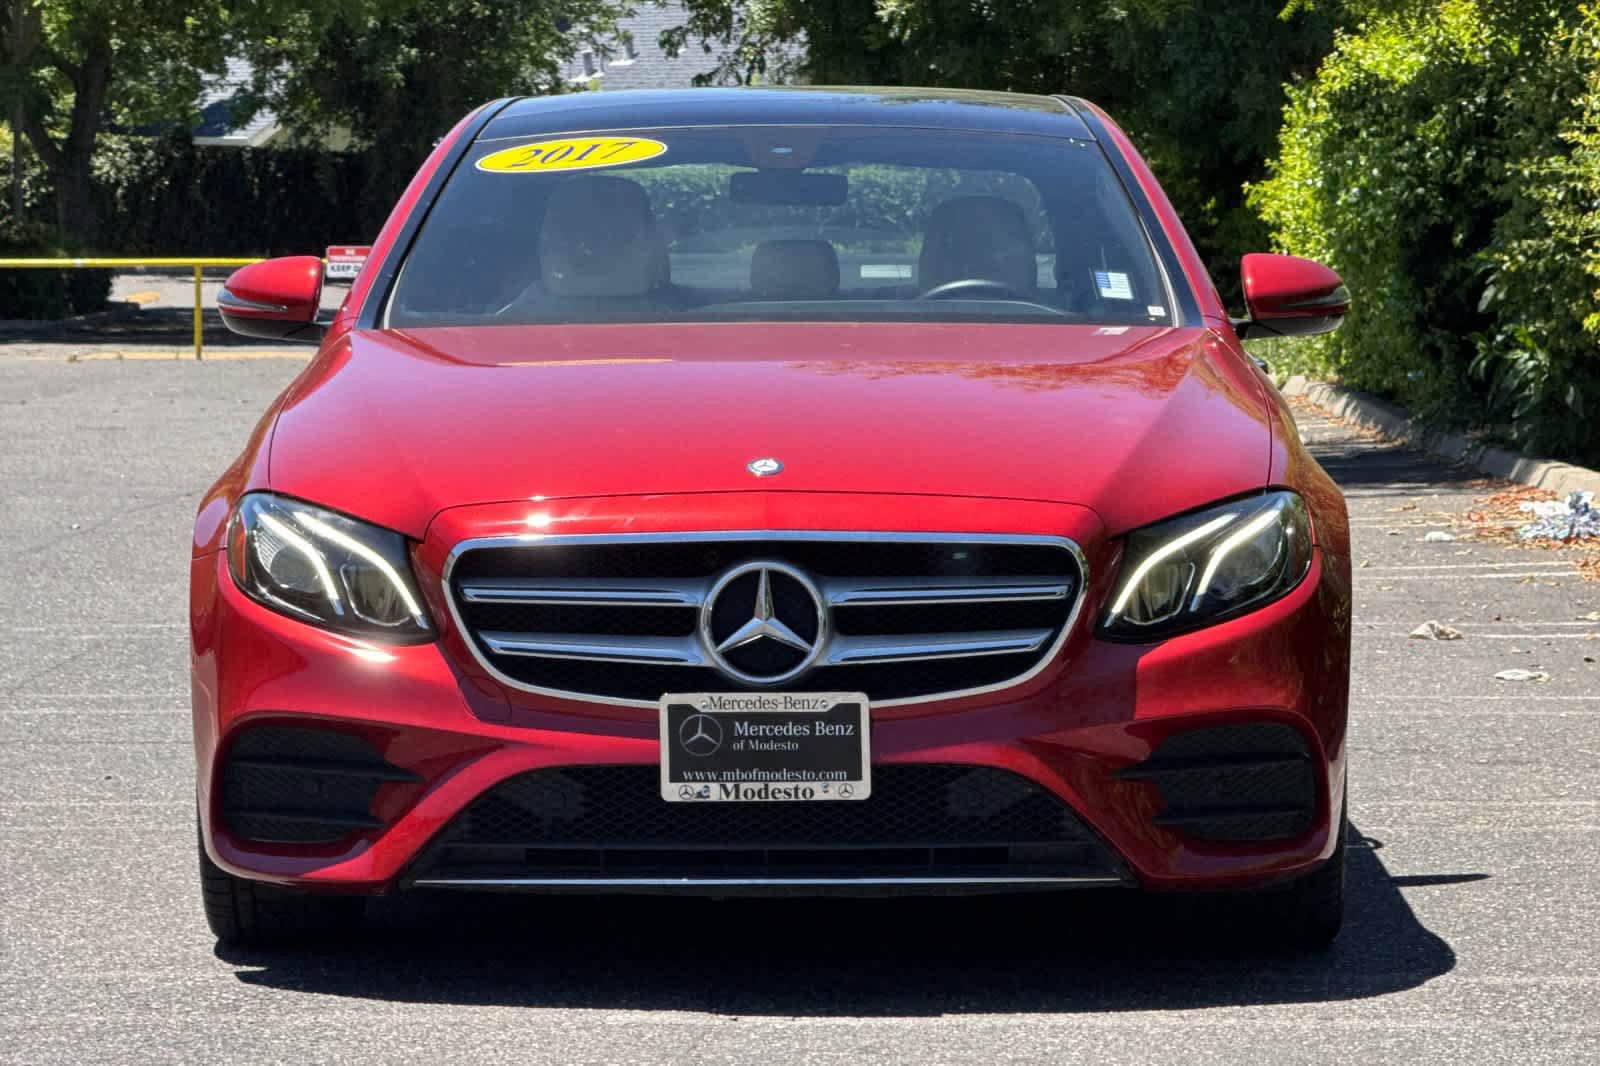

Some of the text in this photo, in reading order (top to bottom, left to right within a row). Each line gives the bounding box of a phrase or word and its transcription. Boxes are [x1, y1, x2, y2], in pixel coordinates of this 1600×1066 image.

[508, 142, 638, 168] 2017
[708, 696, 820, 711] Mercedes-Benz
[733, 721, 854, 736] Mercedes Benz
[733, 740, 799, 751] of Modesto
[682, 768, 847, 781] www.mbofmodesto.com
[718, 783, 815, 801] Modesto
